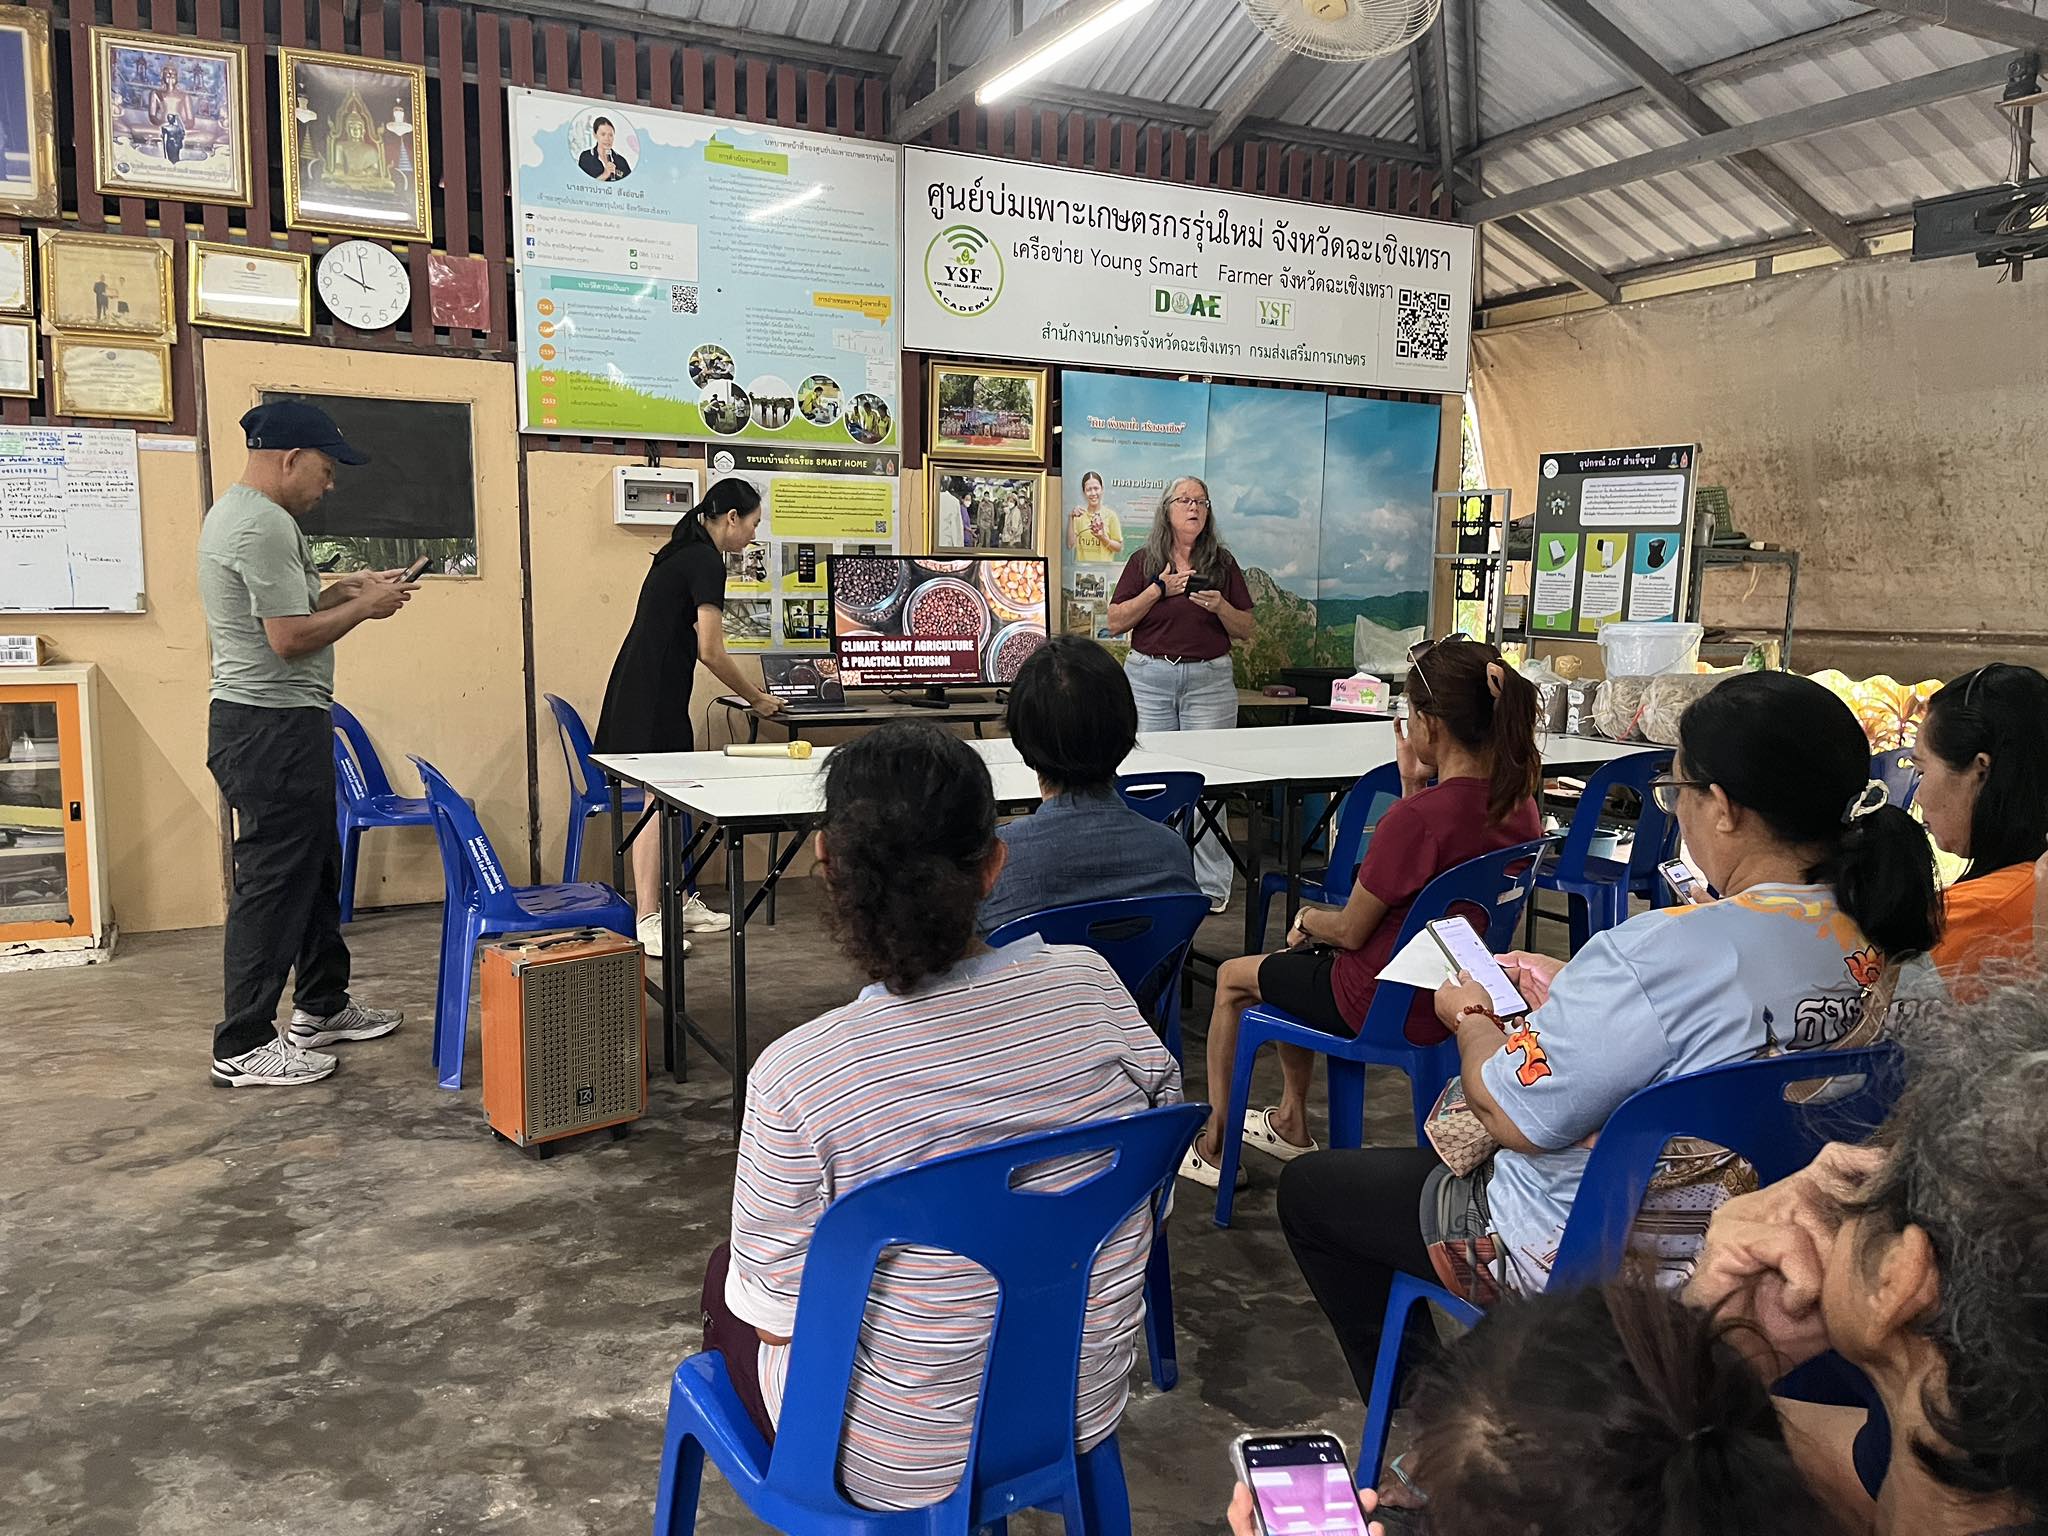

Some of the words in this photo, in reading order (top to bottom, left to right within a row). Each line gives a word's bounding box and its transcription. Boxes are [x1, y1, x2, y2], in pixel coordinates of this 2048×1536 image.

[927, 176, 1264, 252] ศูนย์บ่มเพาะเกษตรกรรุ่นใหม่
[1271, 219, 1452, 273] จังหวัดฉะเชิงเทรา
[944, 265, 982, 284] YSF
[1012, 234, 1083, 266] เครือข่าย
[1090, 250, 1142, 276] Young
[1148, 255, 1198, 279] Smart
[1218, 265, 1274, 287] Farmer
[1279, 267, 1394, 299] จังหวัดฉะเชิงเทรา
[936, 289, 990, 312] ACADEMY
[1258, 300, 1292, 327] YSF
[1041, 320, 1241, 357] สำนักงานเกษตรจังหวัดฉะเชิงเทรา
[1249, 342, 1367, 368] กรมส่งเสริมการเกษตร
[816, 457, 842, 467] SMART
[844, 459, 868, 469] HOME
[1579, 455, 1606, 471] อุปกรณ์
[1607, 457, 1621, 466] IoT
[841, 640, 880, 652] CLIMATE
[882, 640, 913, 652] SMART
[914, 640, 974, 652] AGRICULTURE
[842, 656, 850, 668] &
[851, 656, 902, 668] PRACTICAL
[904, 655, 951, 667] EXTENSION
